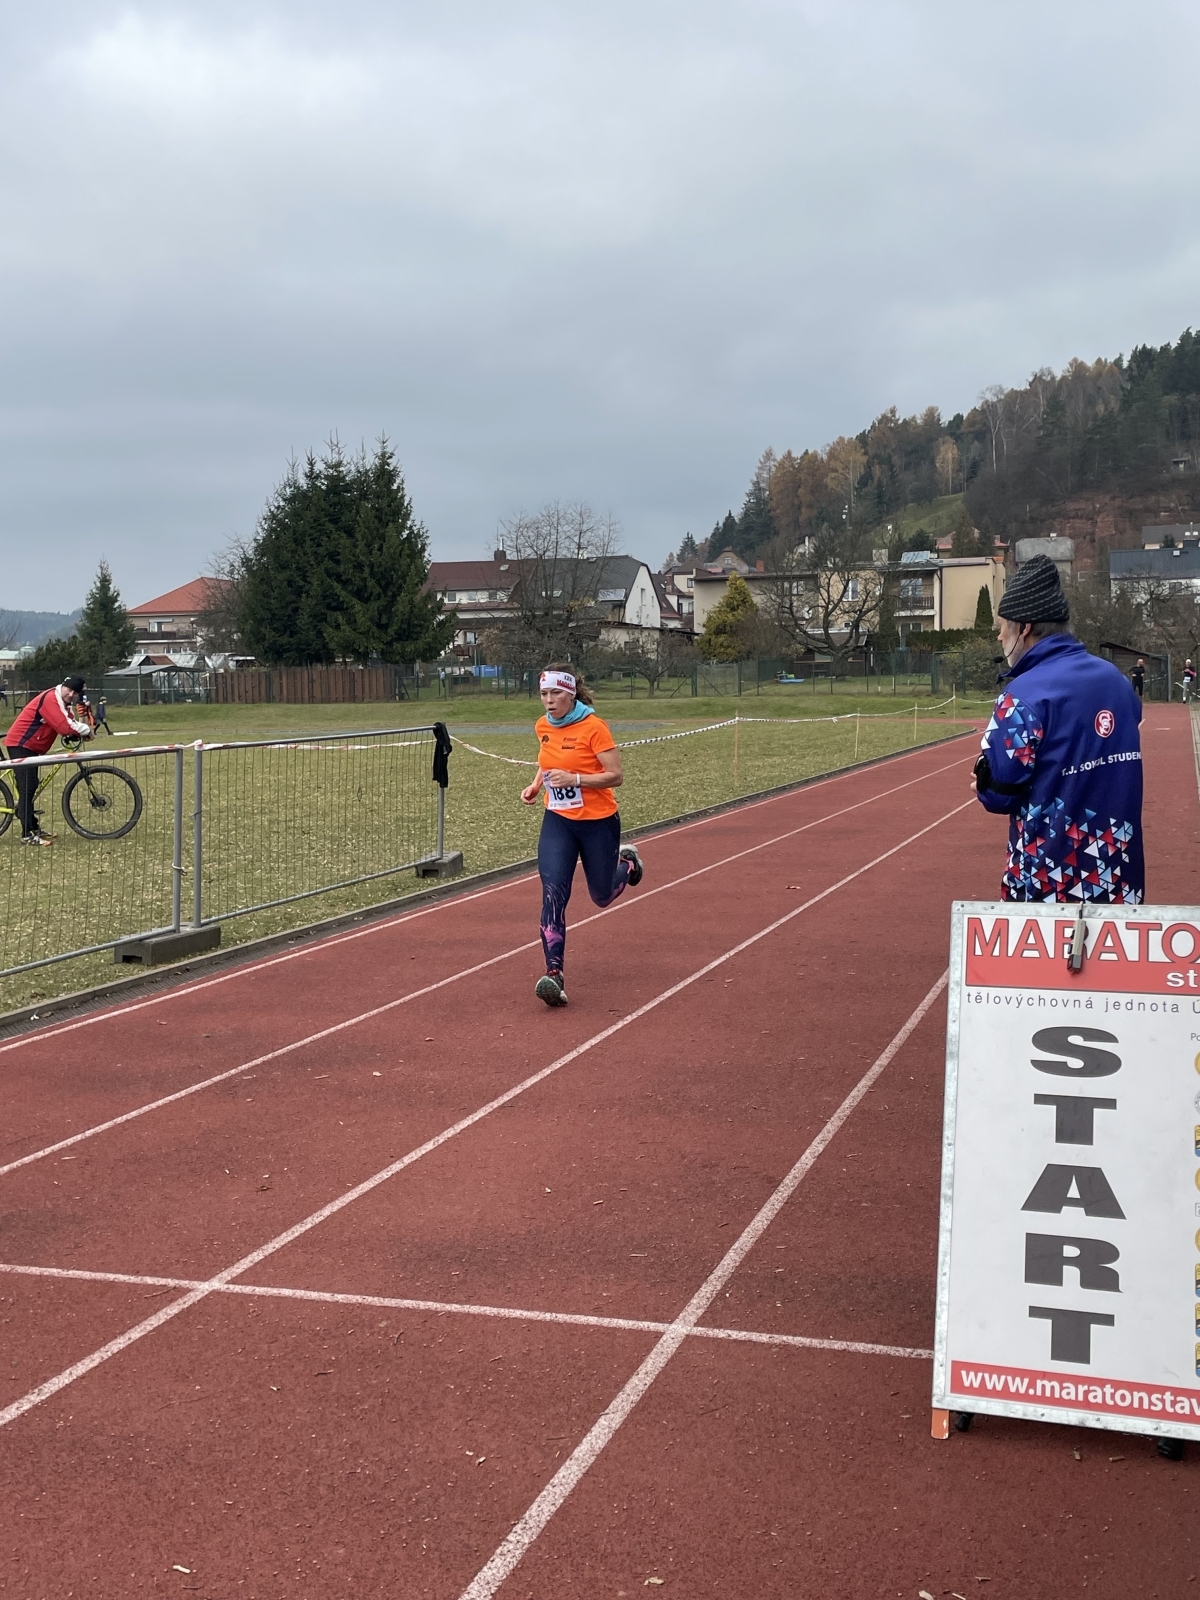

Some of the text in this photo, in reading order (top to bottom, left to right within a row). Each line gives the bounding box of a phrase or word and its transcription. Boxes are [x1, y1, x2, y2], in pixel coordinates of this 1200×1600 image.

[549, 785, 577, 801] 188
[967, 992, 1093, 1009] tělovýchovná
[1105, 999, 1179, 1013] jednota
[1020, 1026, 1127, 1365] START
[961, 1370, 1200, 1417] www.maratonstav
